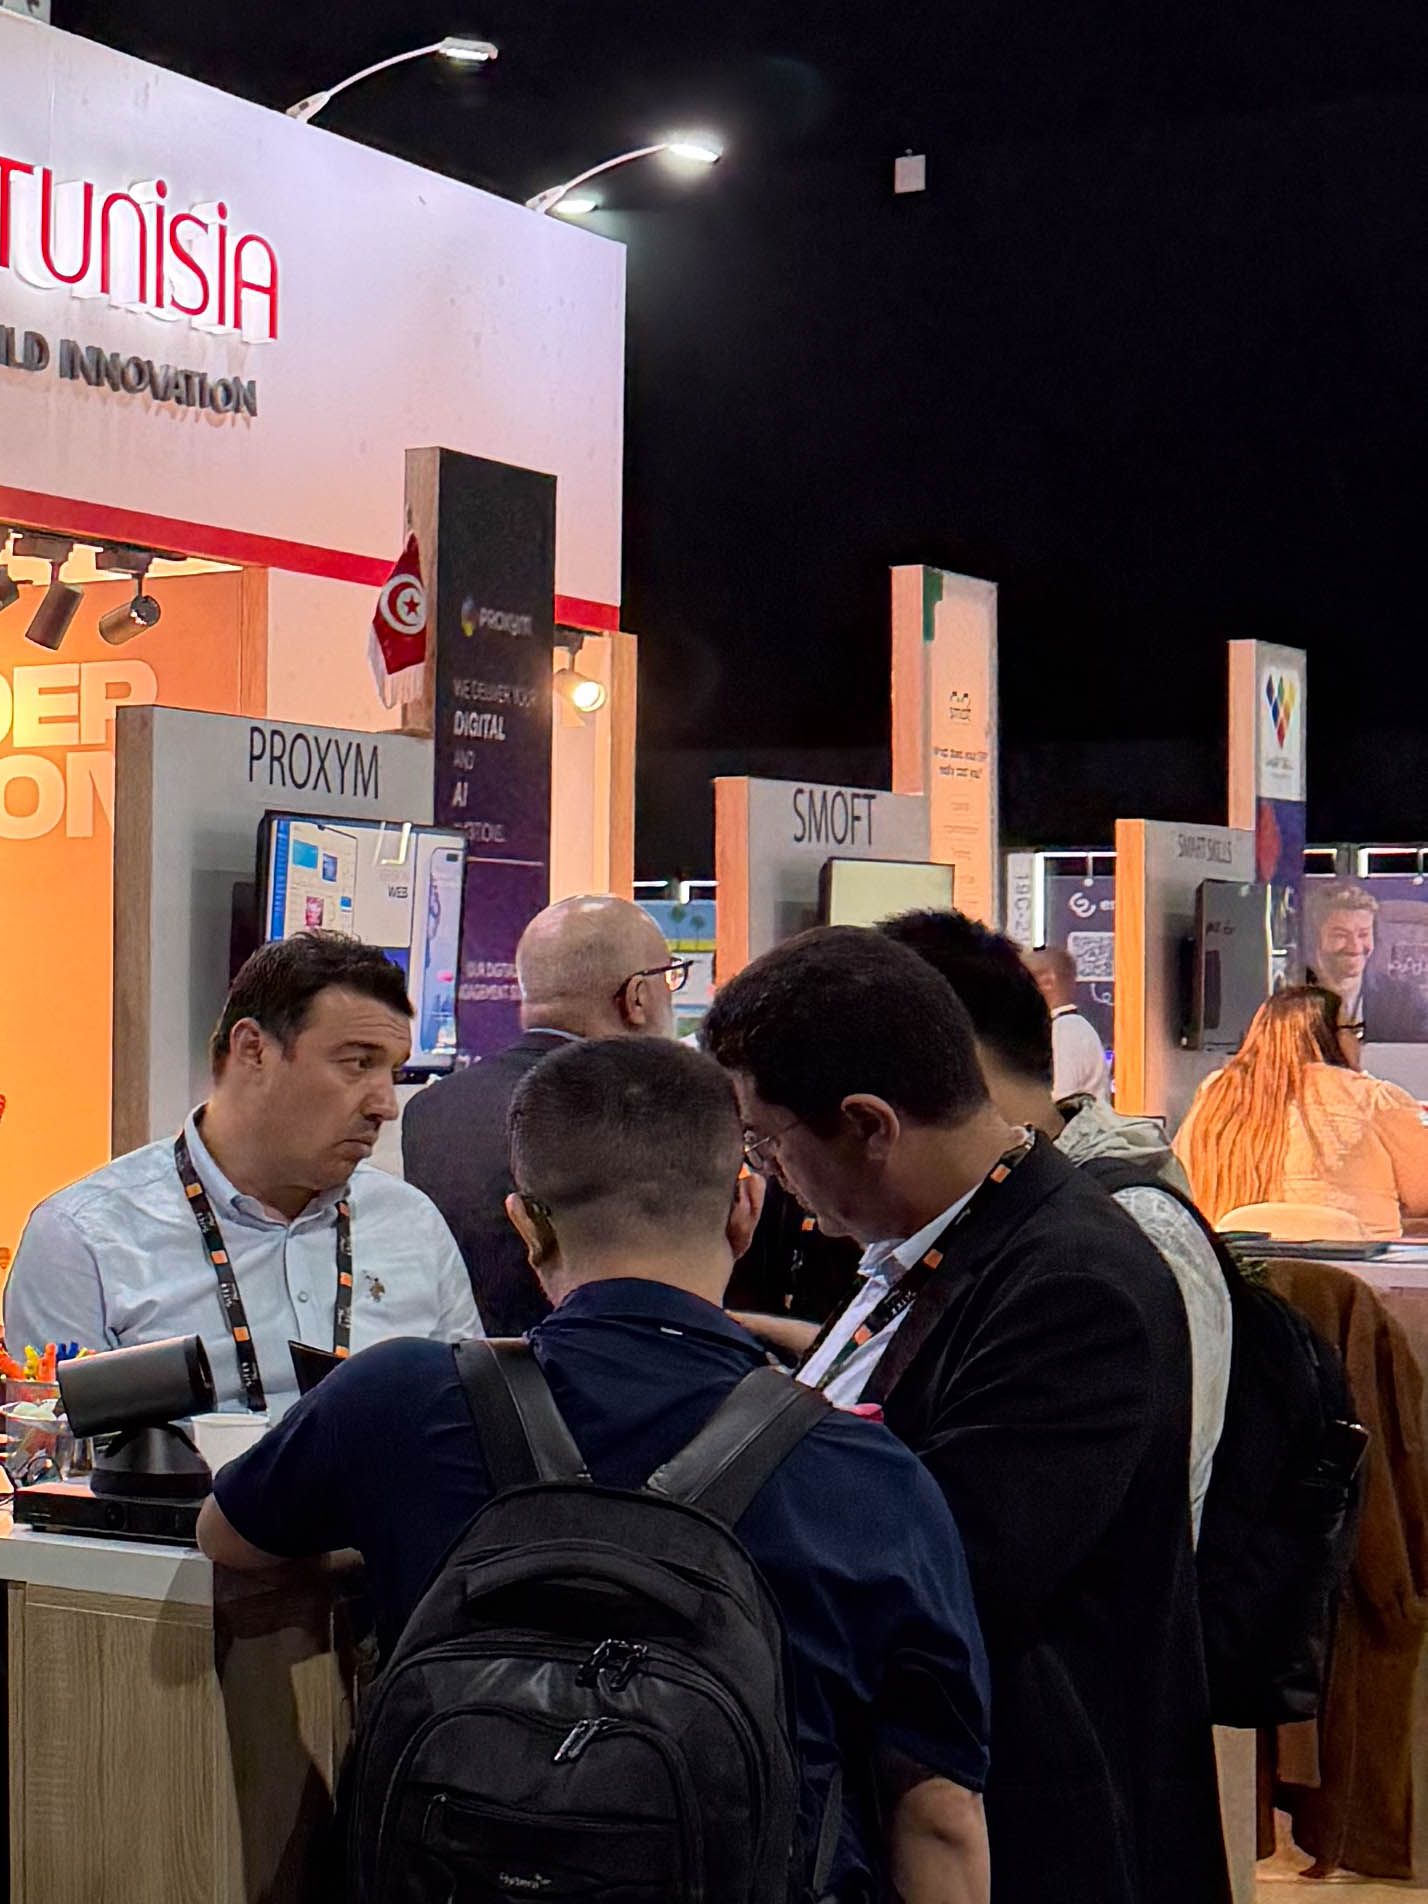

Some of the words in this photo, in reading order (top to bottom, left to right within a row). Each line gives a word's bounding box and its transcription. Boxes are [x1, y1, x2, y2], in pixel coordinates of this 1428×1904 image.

[59, 338, 259, 417] INNOVATION
[453, 710, 506, 741] DIGITAL
[249, 725, 380, 800] PROXYM
[792, 787, 877, 845] SMOFT
